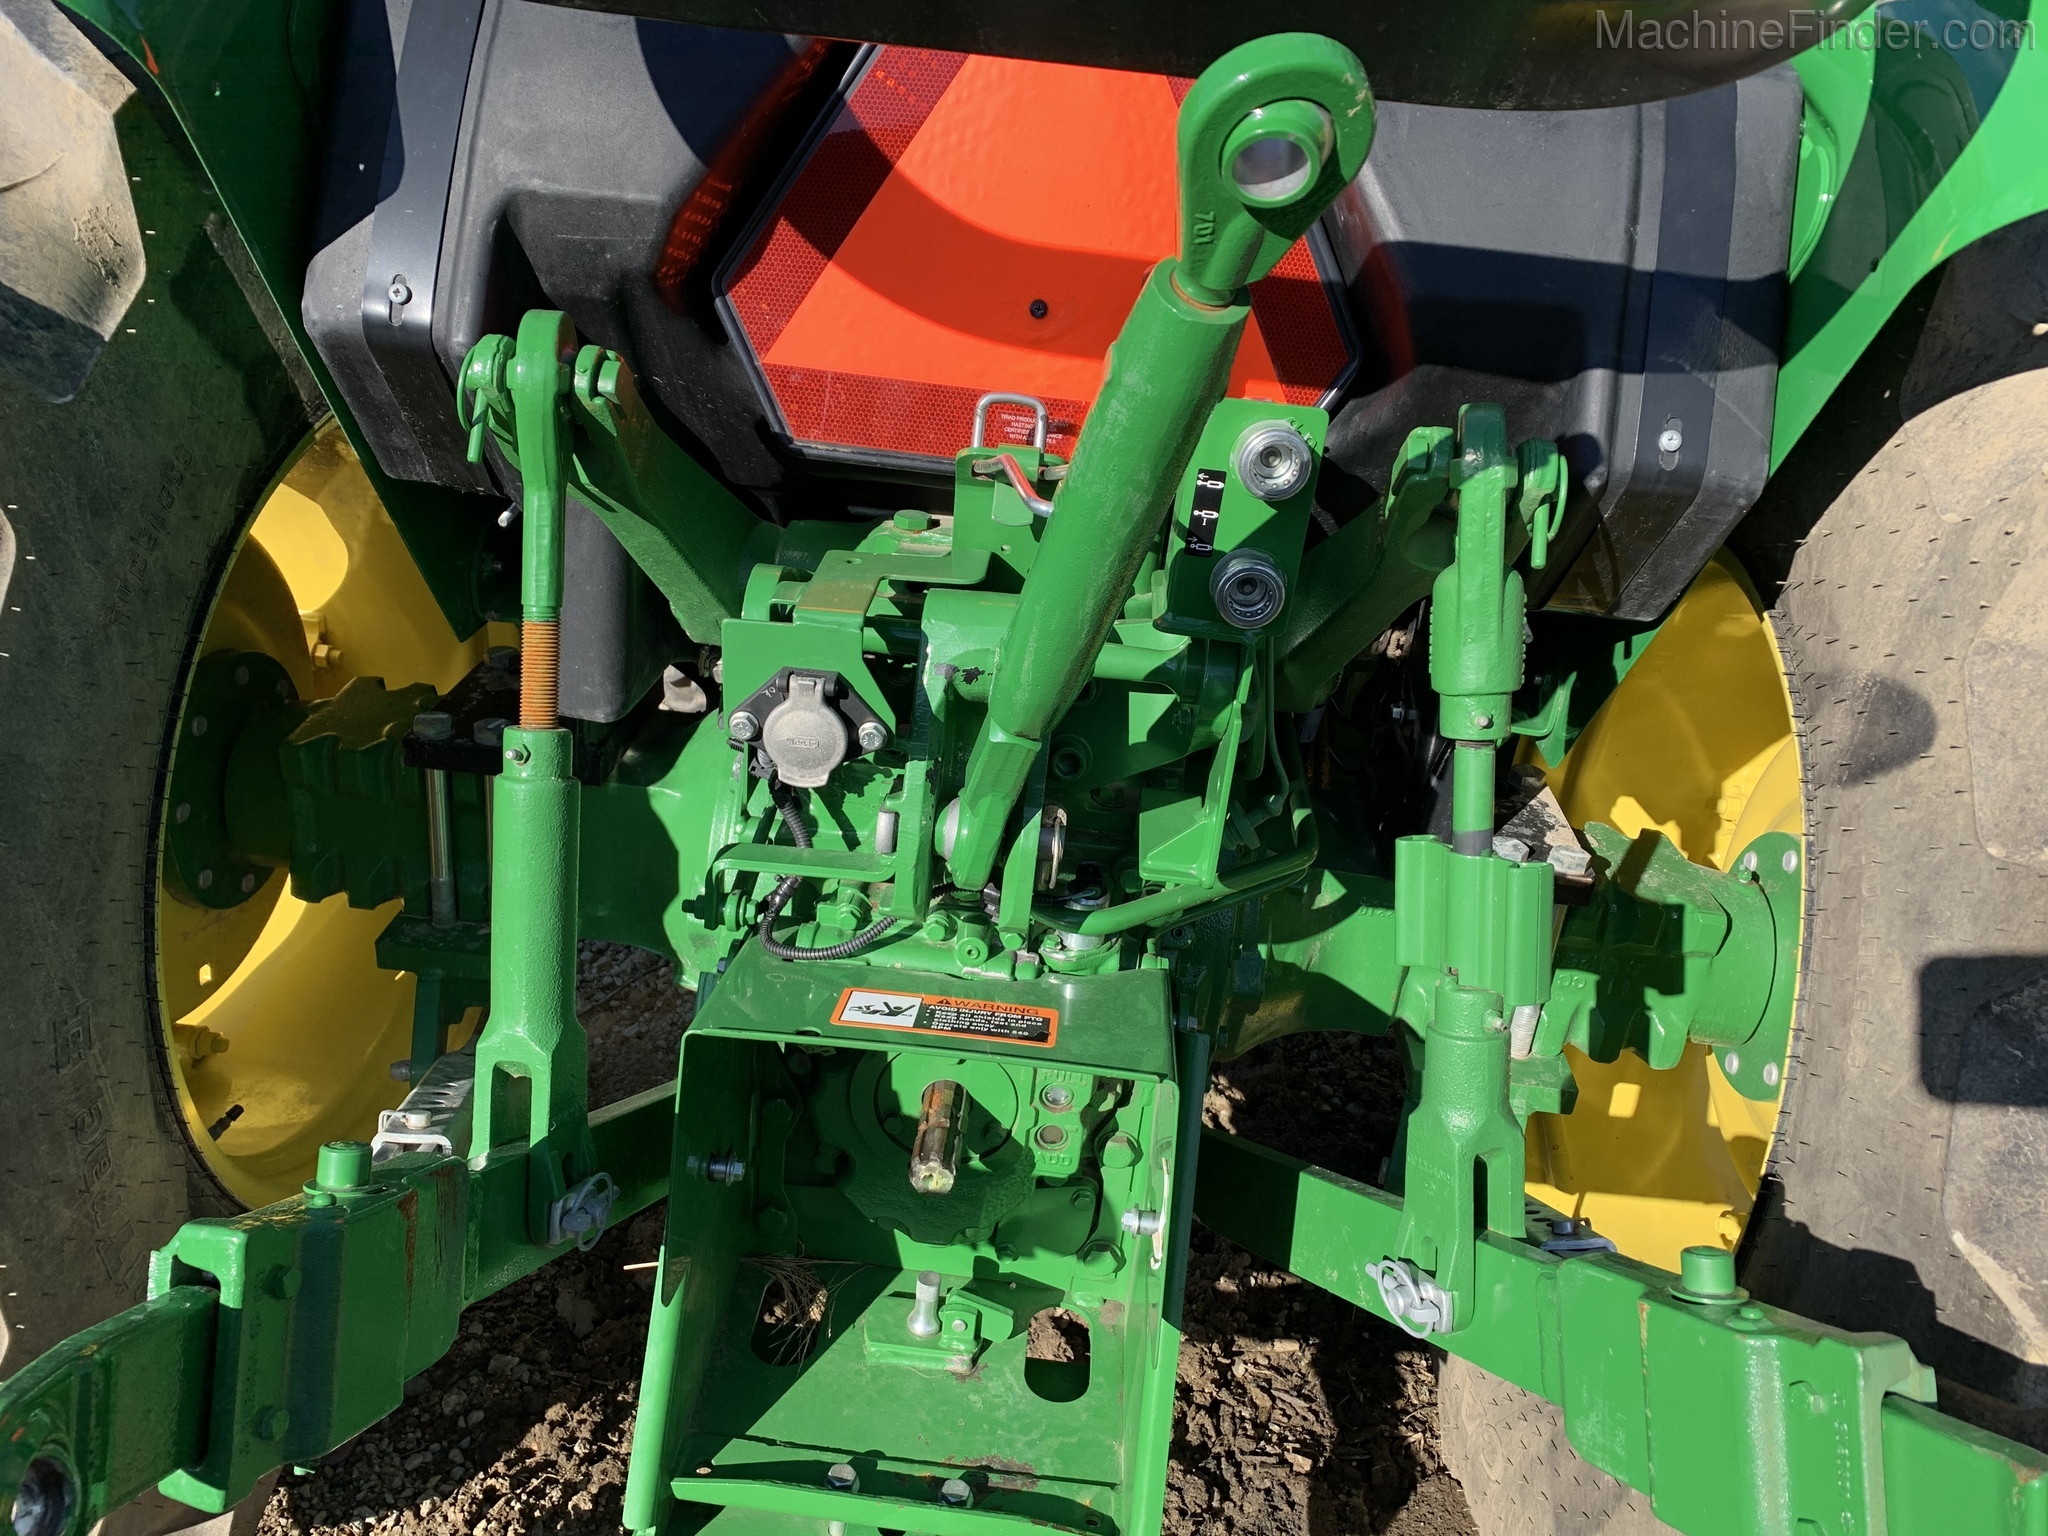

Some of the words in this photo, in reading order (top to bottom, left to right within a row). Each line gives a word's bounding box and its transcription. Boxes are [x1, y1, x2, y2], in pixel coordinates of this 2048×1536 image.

[109, 441, 192, 627] TUBELESS
[954, 1000, 1039, 1015] WARNING
[932, 1021, 968, 1029] Operate
[1043, 1070, 1087, 1086] FULL
[1036, 1150, 1073, 1166] ADD
